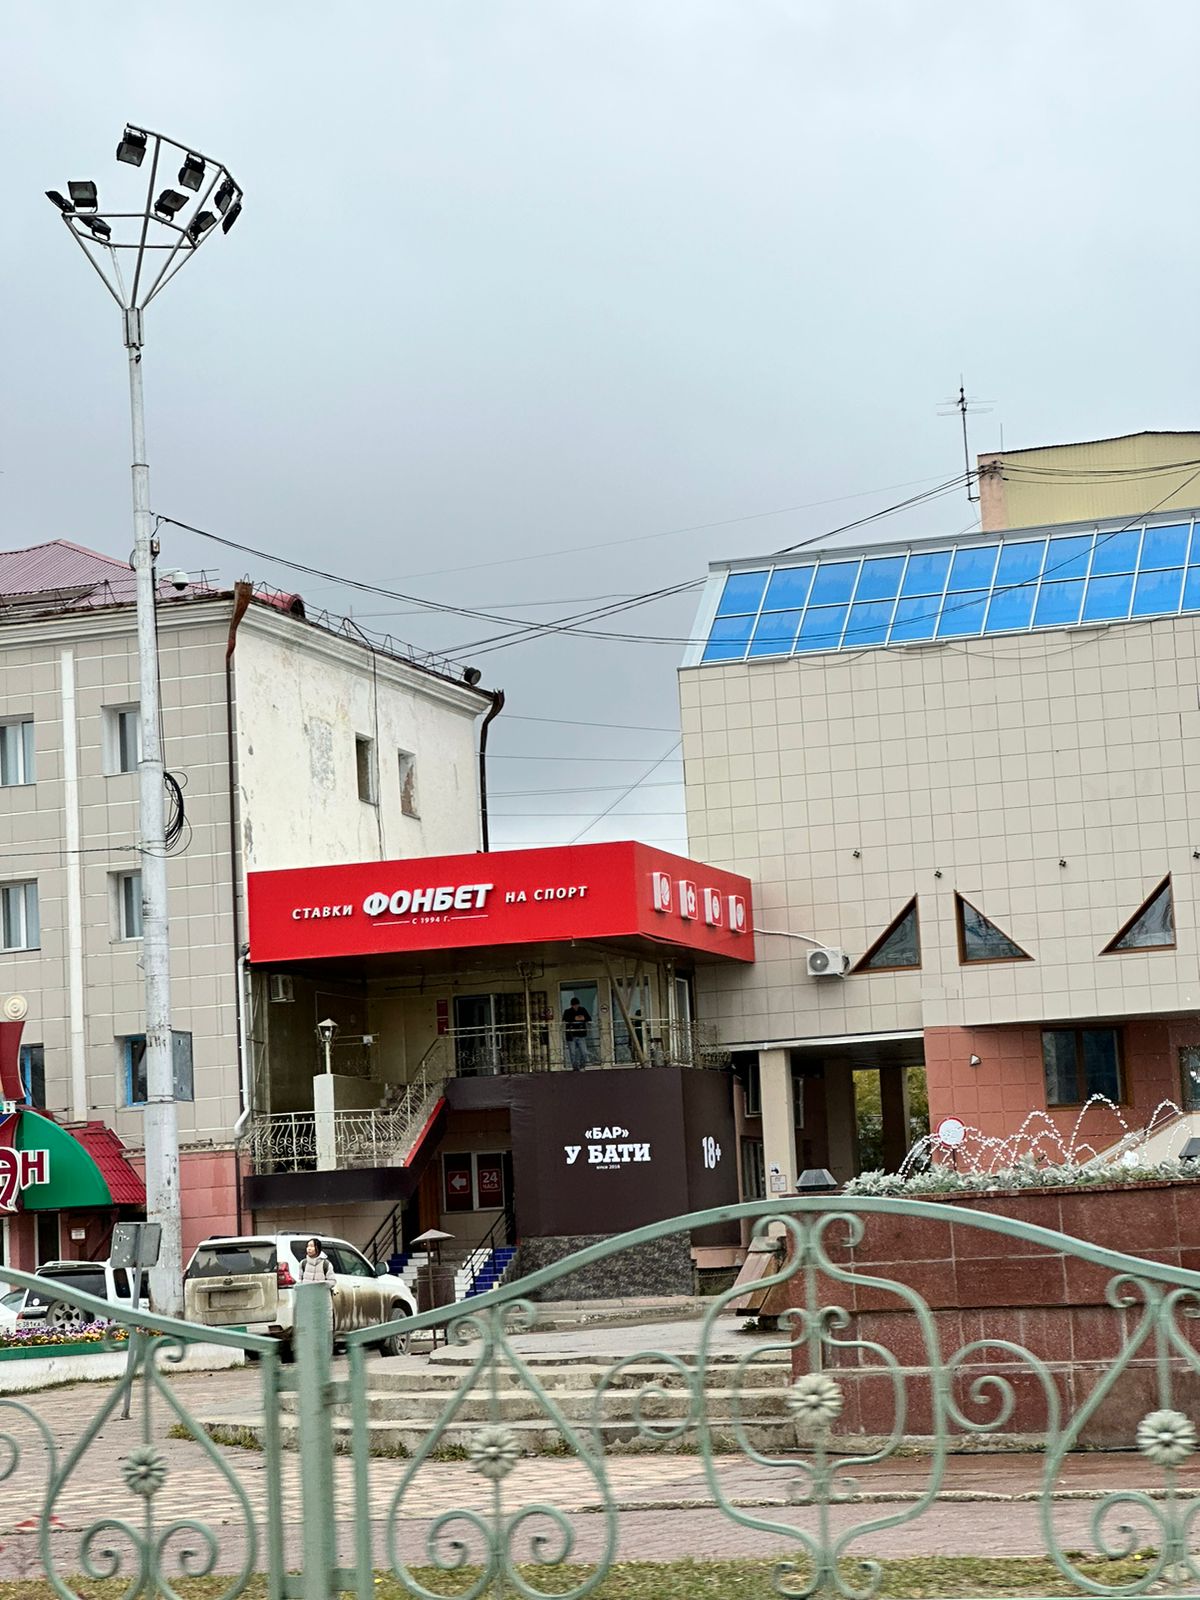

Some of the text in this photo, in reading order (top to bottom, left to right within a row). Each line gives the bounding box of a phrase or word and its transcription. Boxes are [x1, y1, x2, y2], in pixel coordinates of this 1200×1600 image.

[363, 883, 494, 917] ФОНБЕТ
[504, 884, 588, 904] НА СПОРТ
[292, 903, 353, 920] СТАВКИ
[420, 916, 440, 924] 1994
[584, 1126, 629, 1140] «БАР»
[564, 1143, 652, 1165] У БАТИ
[702, 1136, 722, 1169] 18+
[482, 1171, 498, 1184] 24
